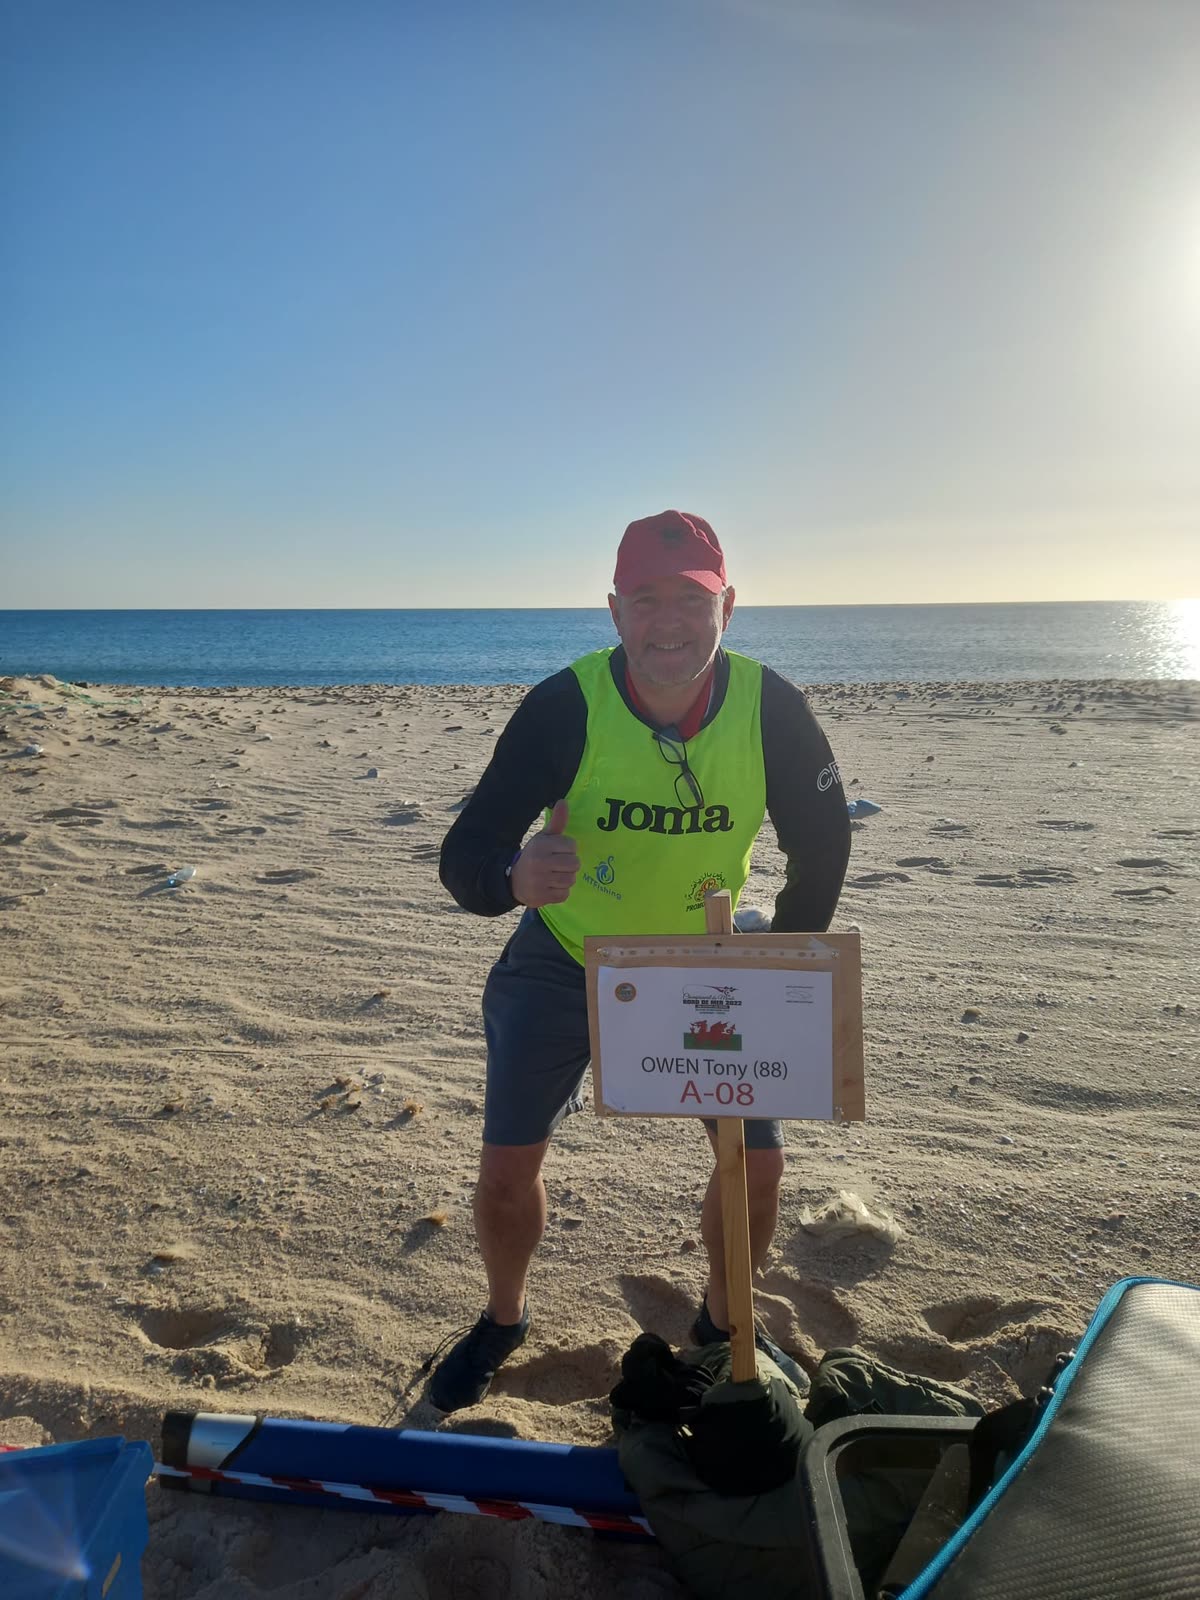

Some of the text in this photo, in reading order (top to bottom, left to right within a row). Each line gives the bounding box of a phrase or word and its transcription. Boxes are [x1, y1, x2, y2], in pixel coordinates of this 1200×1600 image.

[596, 797, 735, 835] Joma
[641, 1056, 788, 1081] OWEN Tony (88)
[679, 1080, 755, 1106] A-08
